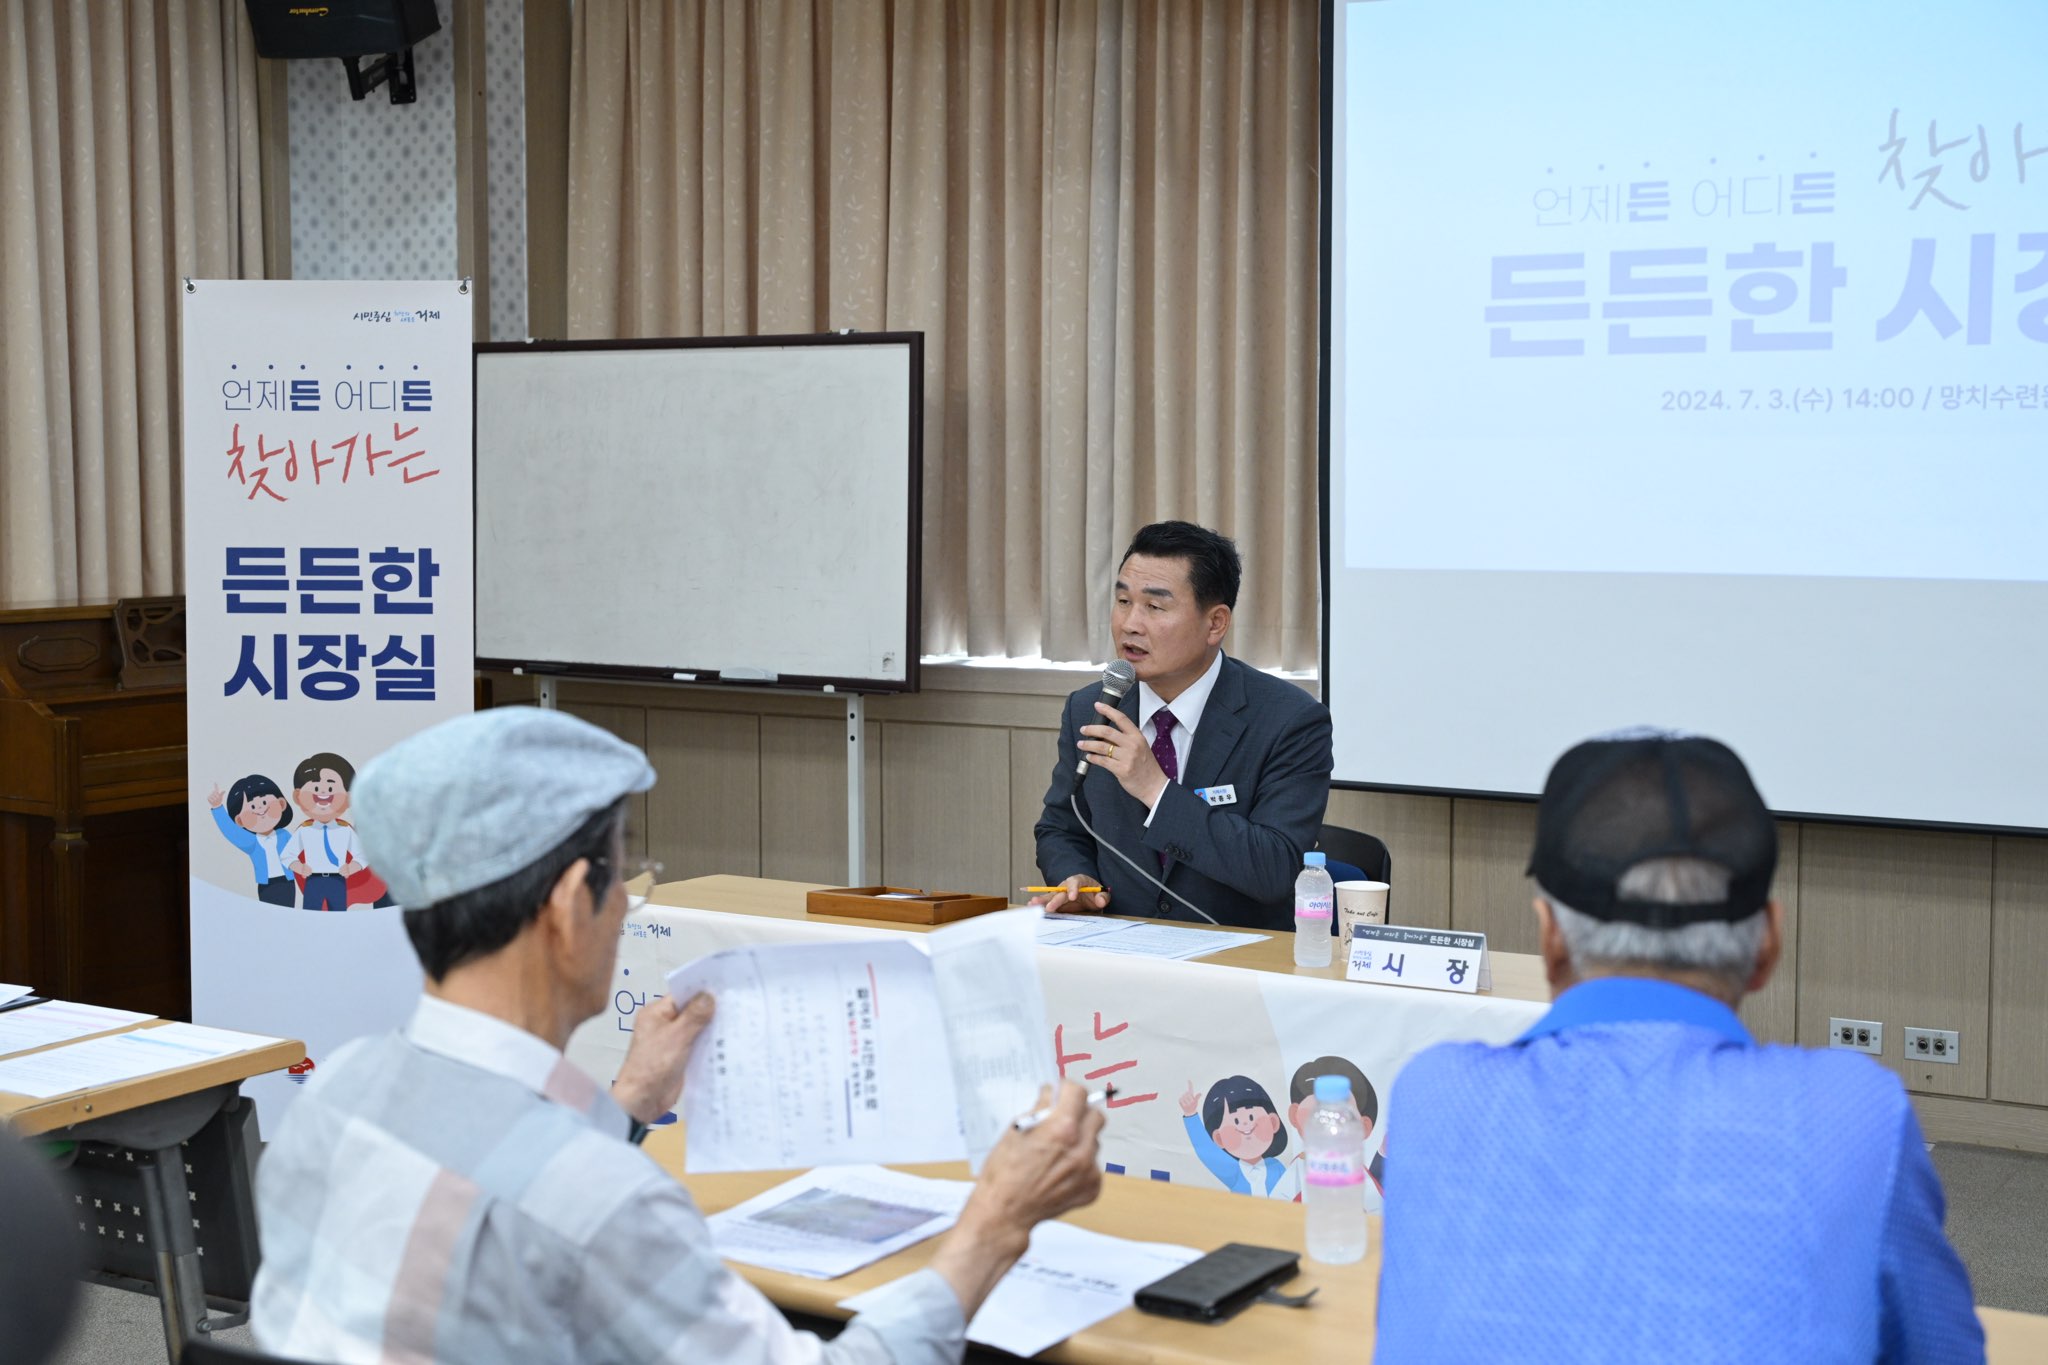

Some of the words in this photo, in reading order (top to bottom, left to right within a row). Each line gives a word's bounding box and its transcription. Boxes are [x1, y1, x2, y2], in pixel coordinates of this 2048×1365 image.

[1532, 180, 1671, 227] 언제든
[1691, 170, 1837, 219] 어디든
[1484, 241, 1848, 358] 든든한
[353, 310, 392, 323] 시민중심
[415, 309, 441, 323] 거제
[222, 380, 321, 411] 언제든
[334, 380, 433, 412] 어디든
[1661, 389, 1733, 412] 2024.
[1738, 389, 1761, 411] 7.
[1841, 387, 1916, 410] 14:00
[226, 422, 440, 502] 찾아가는
[222, 546, 440, 614] 든든한
[224, 634, 436, 701] 시장실
[647, 923, 671, 939] 거제
[1453, 936, 1475, 948] 시장실
[1352, 959, 1372, 973] 거제
